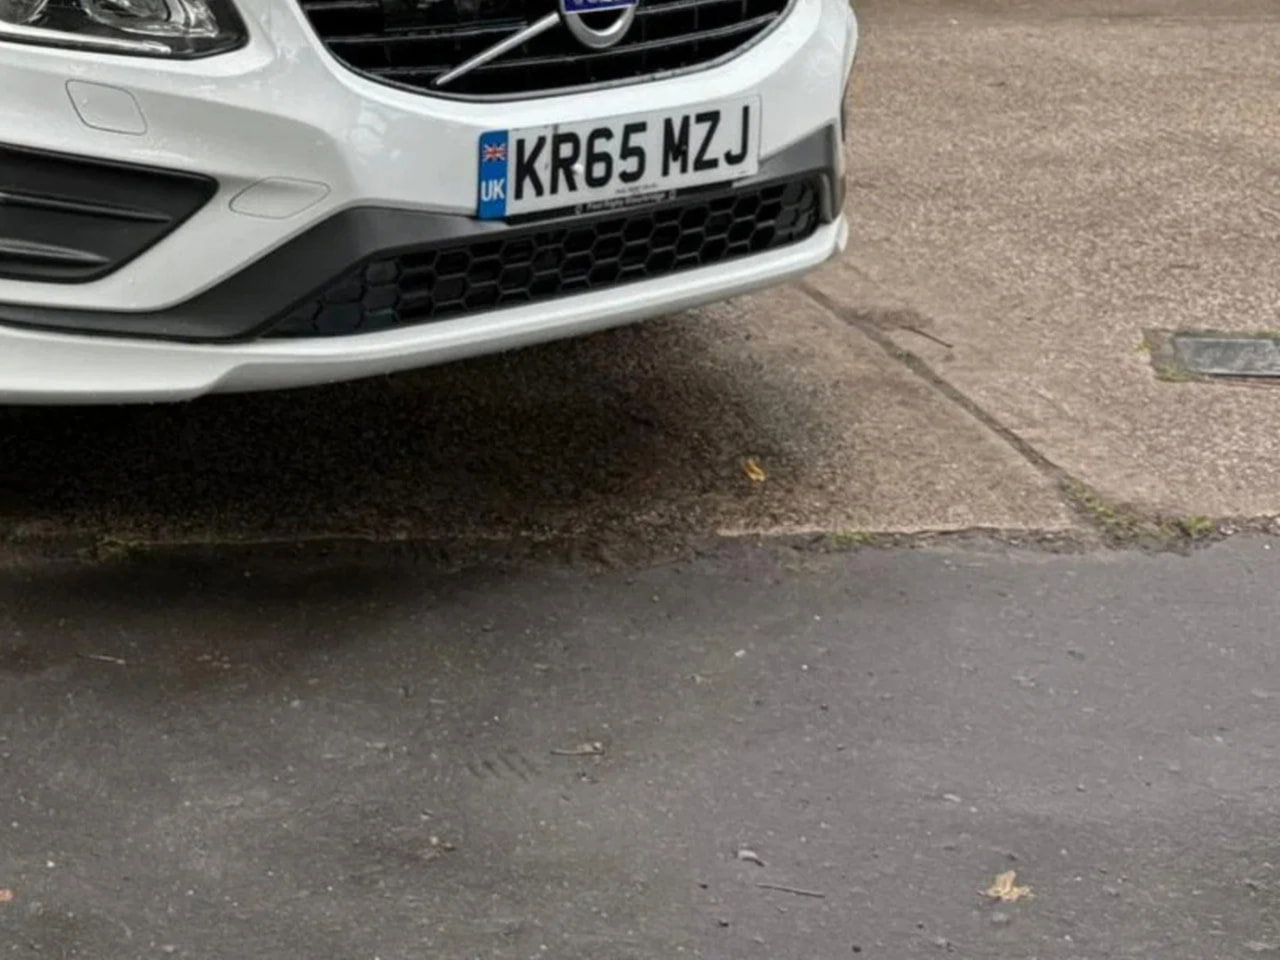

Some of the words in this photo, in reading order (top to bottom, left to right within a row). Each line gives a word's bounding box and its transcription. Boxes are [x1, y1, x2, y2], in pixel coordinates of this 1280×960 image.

[481, 179, 505, 202] UK
[514, 121, 648, 201] KR65
[661, 105, 750, 178] MZJ
